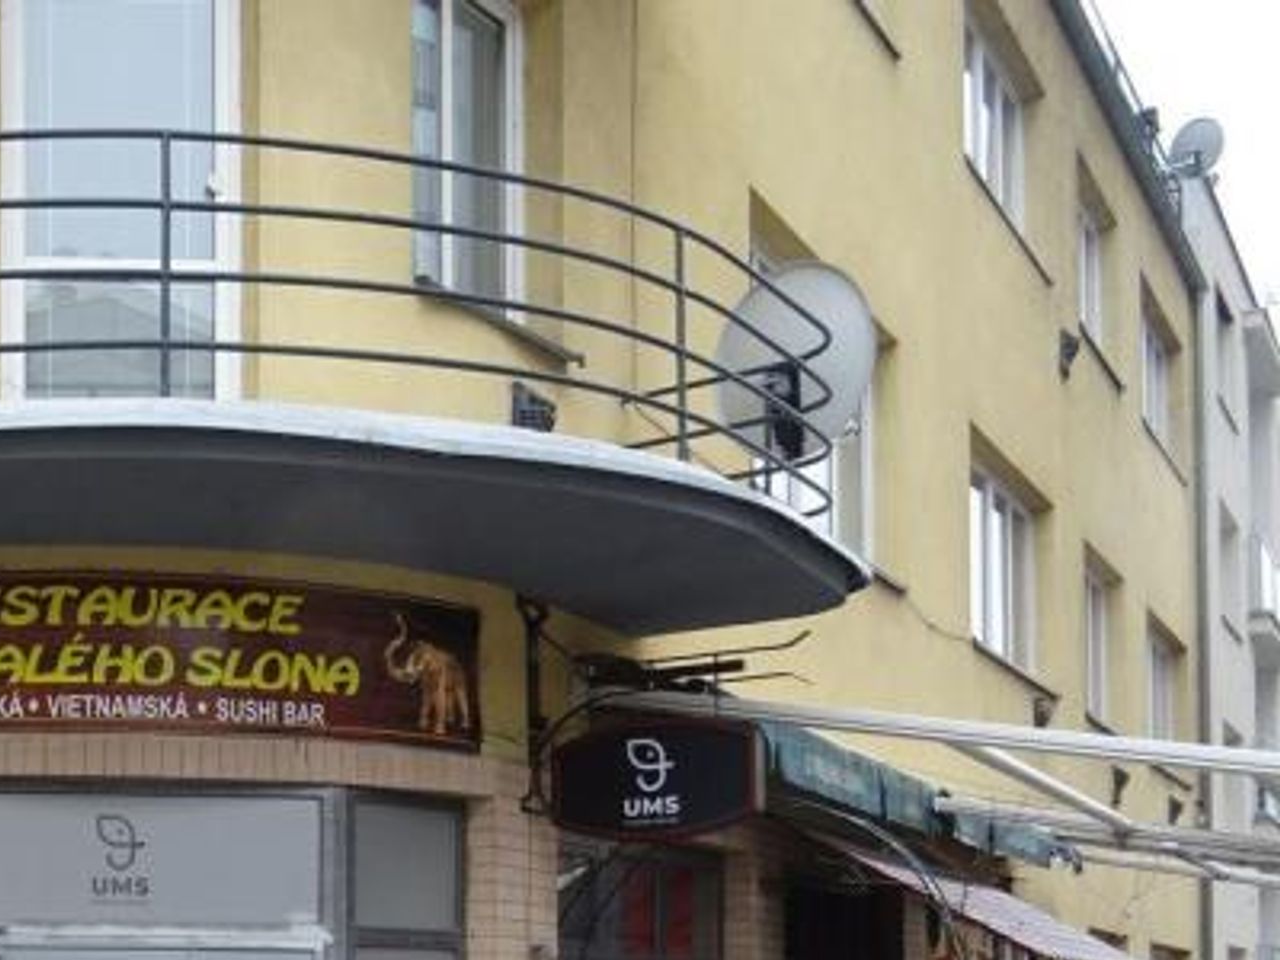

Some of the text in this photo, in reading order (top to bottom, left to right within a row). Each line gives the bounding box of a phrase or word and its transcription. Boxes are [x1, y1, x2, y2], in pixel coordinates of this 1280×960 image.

[186, 647, 360, 696] SLONA
[47, 692, 188, 719] VIETNAMSKÁ
[217, 698, 277, 723] SUSHI
[283, 702, 326, 728] BAR
[623, 796, 680, 817] UMS
[92, 876, 149, 896] UMS
